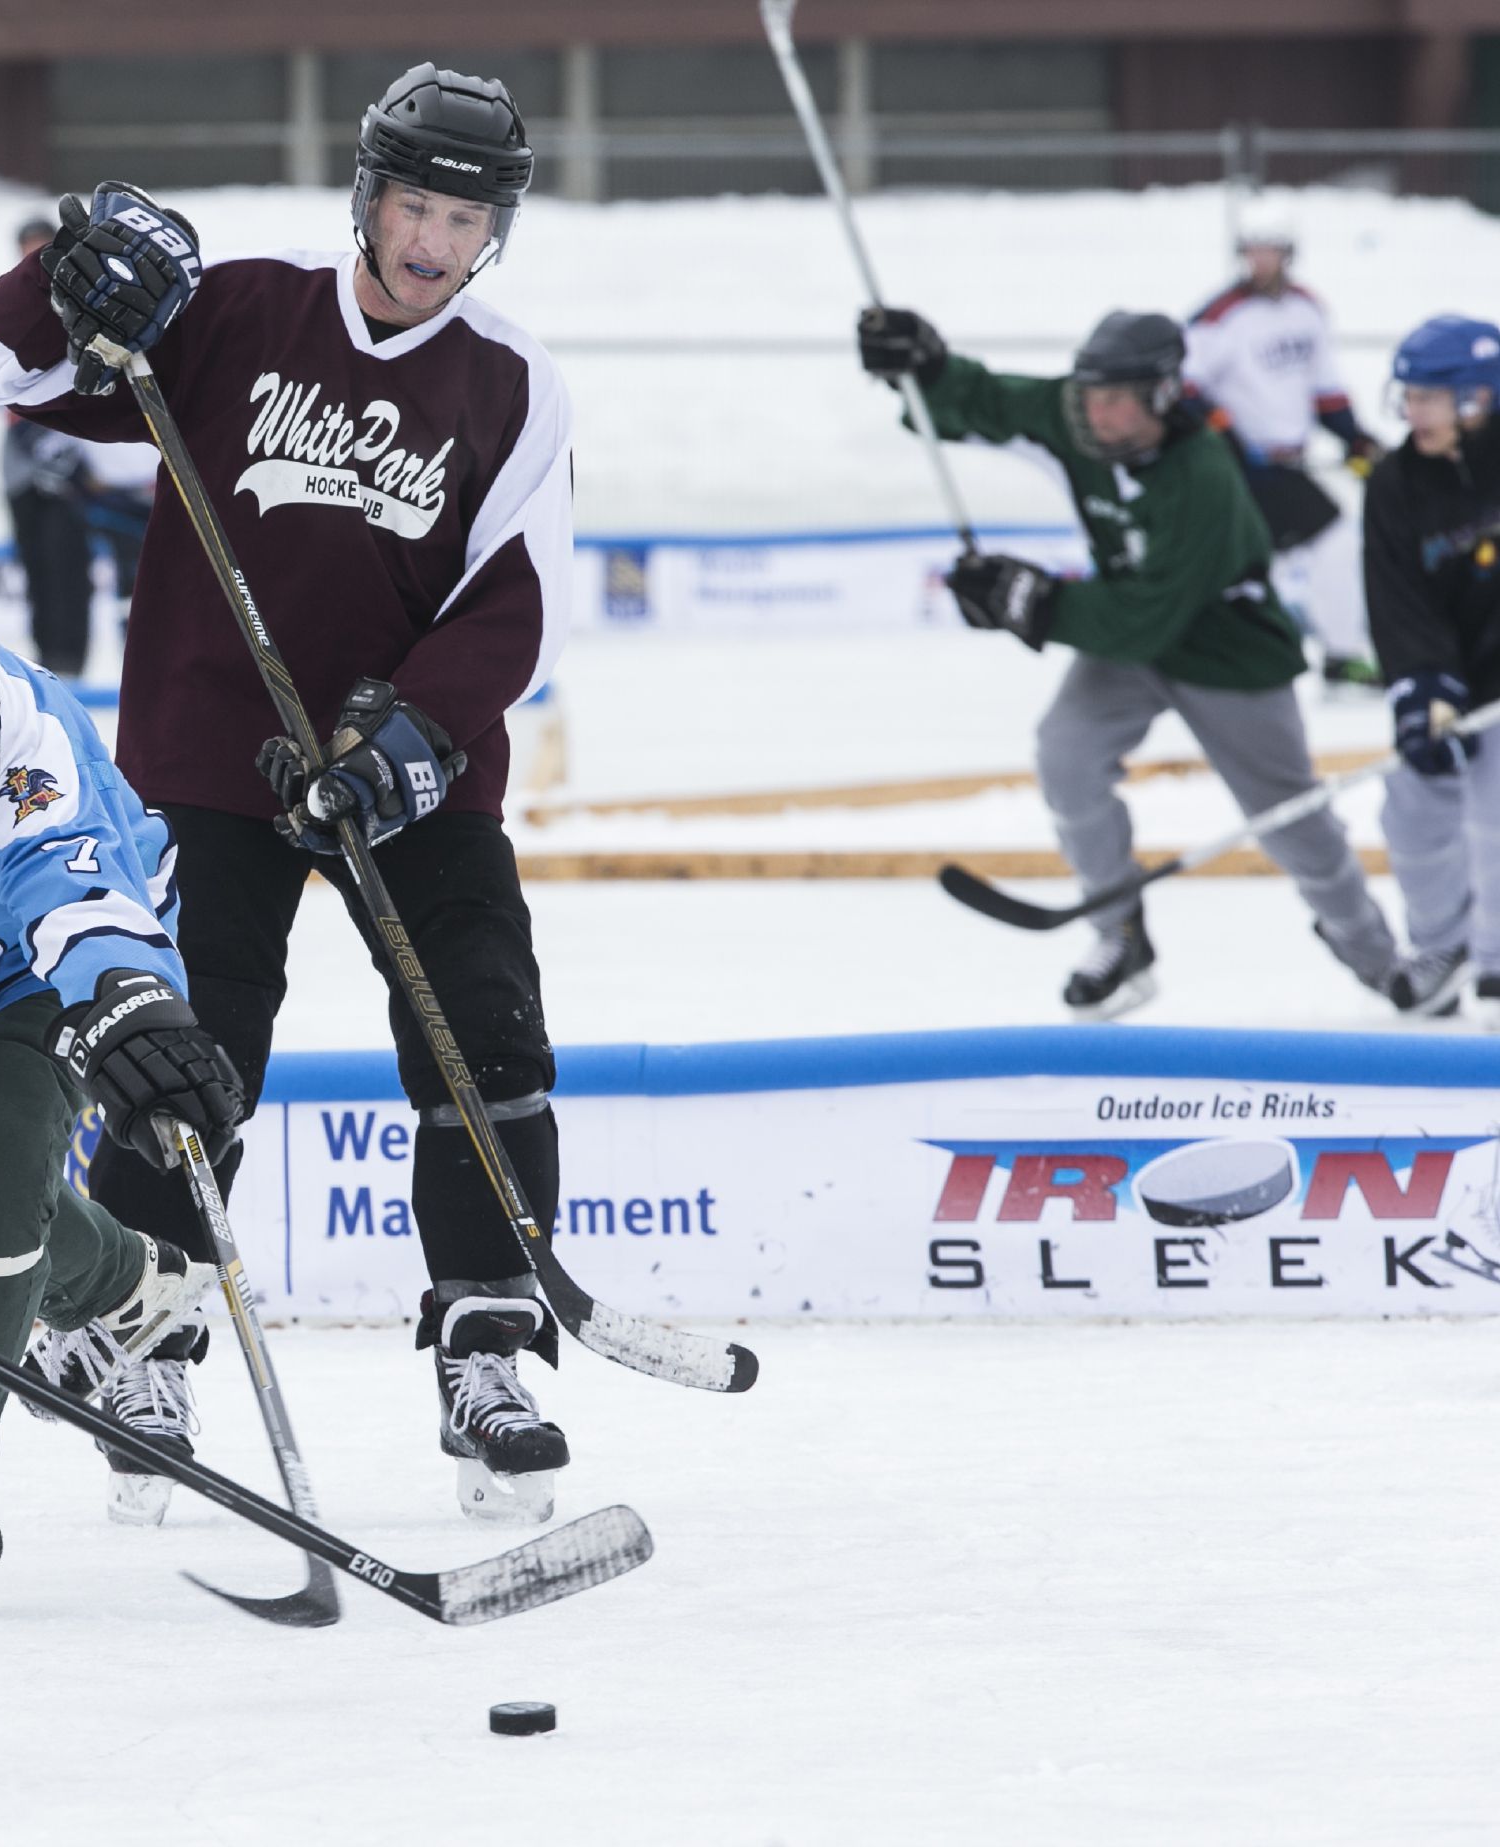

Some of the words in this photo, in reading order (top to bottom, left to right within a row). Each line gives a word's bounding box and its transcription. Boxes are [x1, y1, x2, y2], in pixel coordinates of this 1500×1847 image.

[112, 206, 202, 312] BAU
[246, 371, 354, 467] White
[353, 399, 455, 509] Park
[305, 475, 358, 498] HOCKE
[362, 499, 384, 521] UB
[39, 835, 101, 875] 7
[85, 987, 175, 1048] FARRELL
[1096, 1095, 1201, 1122] Outdoor
[1210, 1095, 1251, 1120] Ice
[1261, 1092, 1336, 1119] Rinks
[321, 1111, 409, 1162] We
[927, 1235, 1454, 1290] SLEEK
